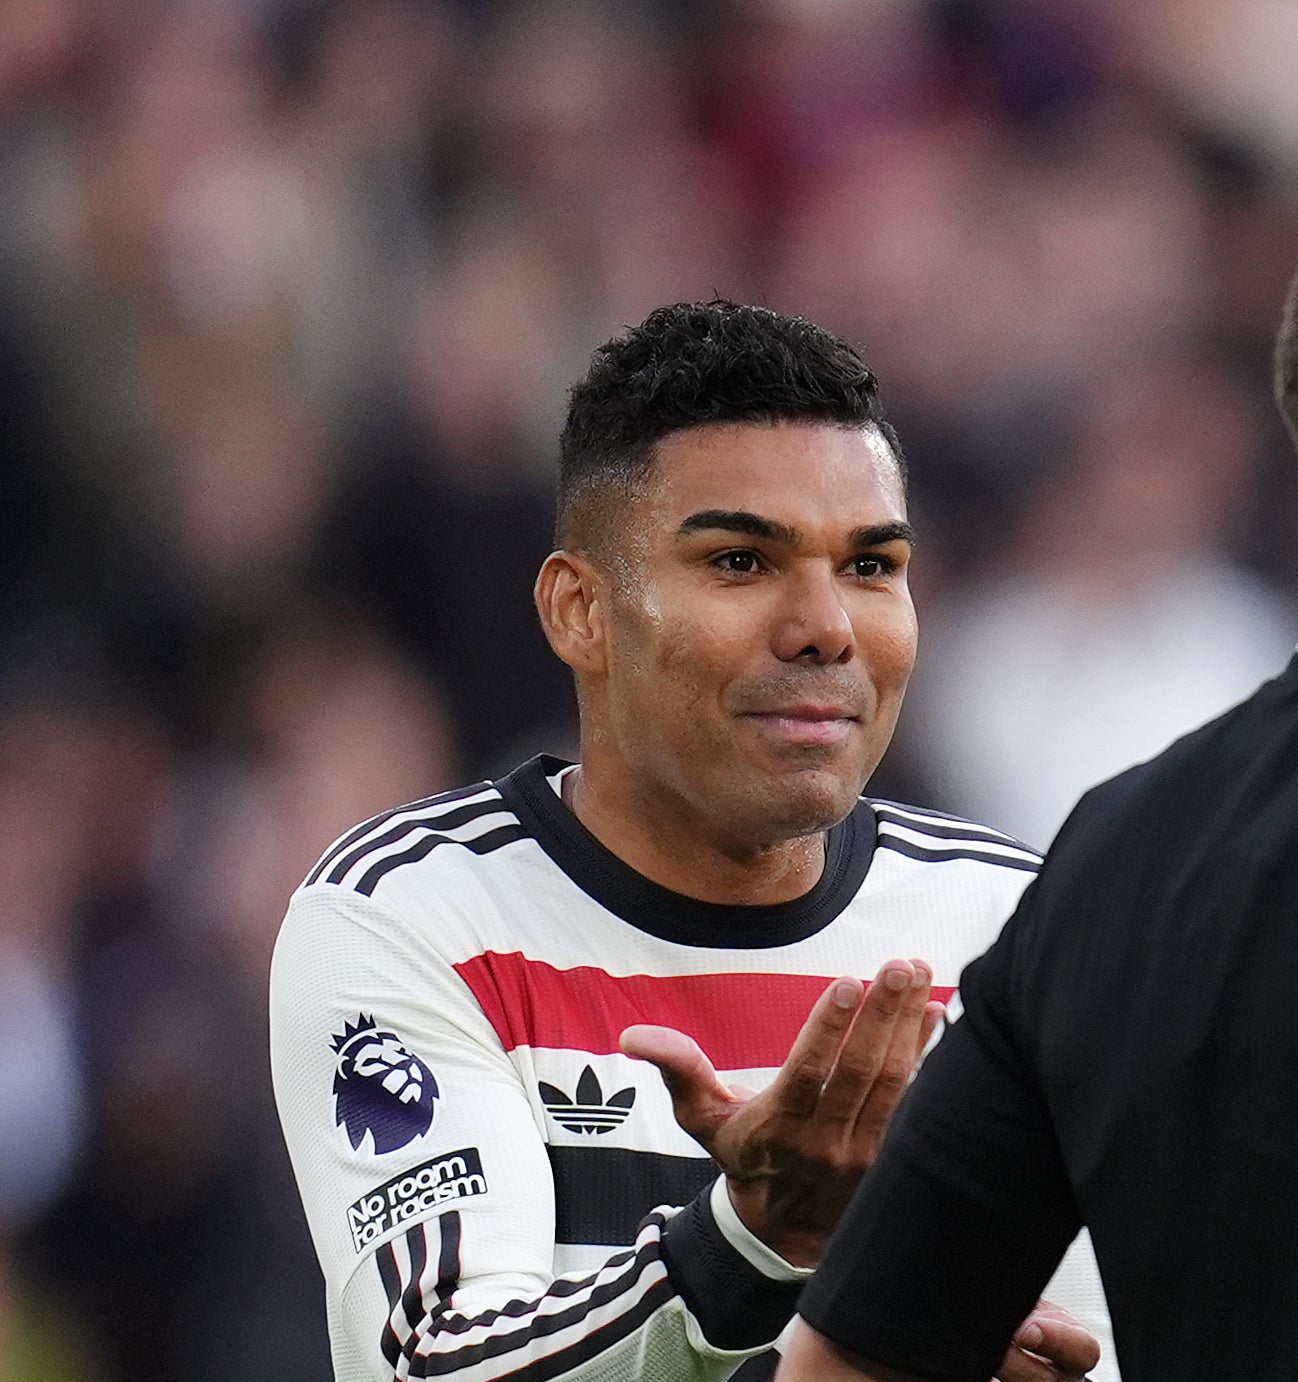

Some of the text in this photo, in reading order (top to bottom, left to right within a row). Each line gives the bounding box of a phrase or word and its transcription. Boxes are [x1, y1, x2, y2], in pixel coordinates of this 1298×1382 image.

[348, 1156, 468, 1231] No room
[351, 1174, 487, 1253] for racism
